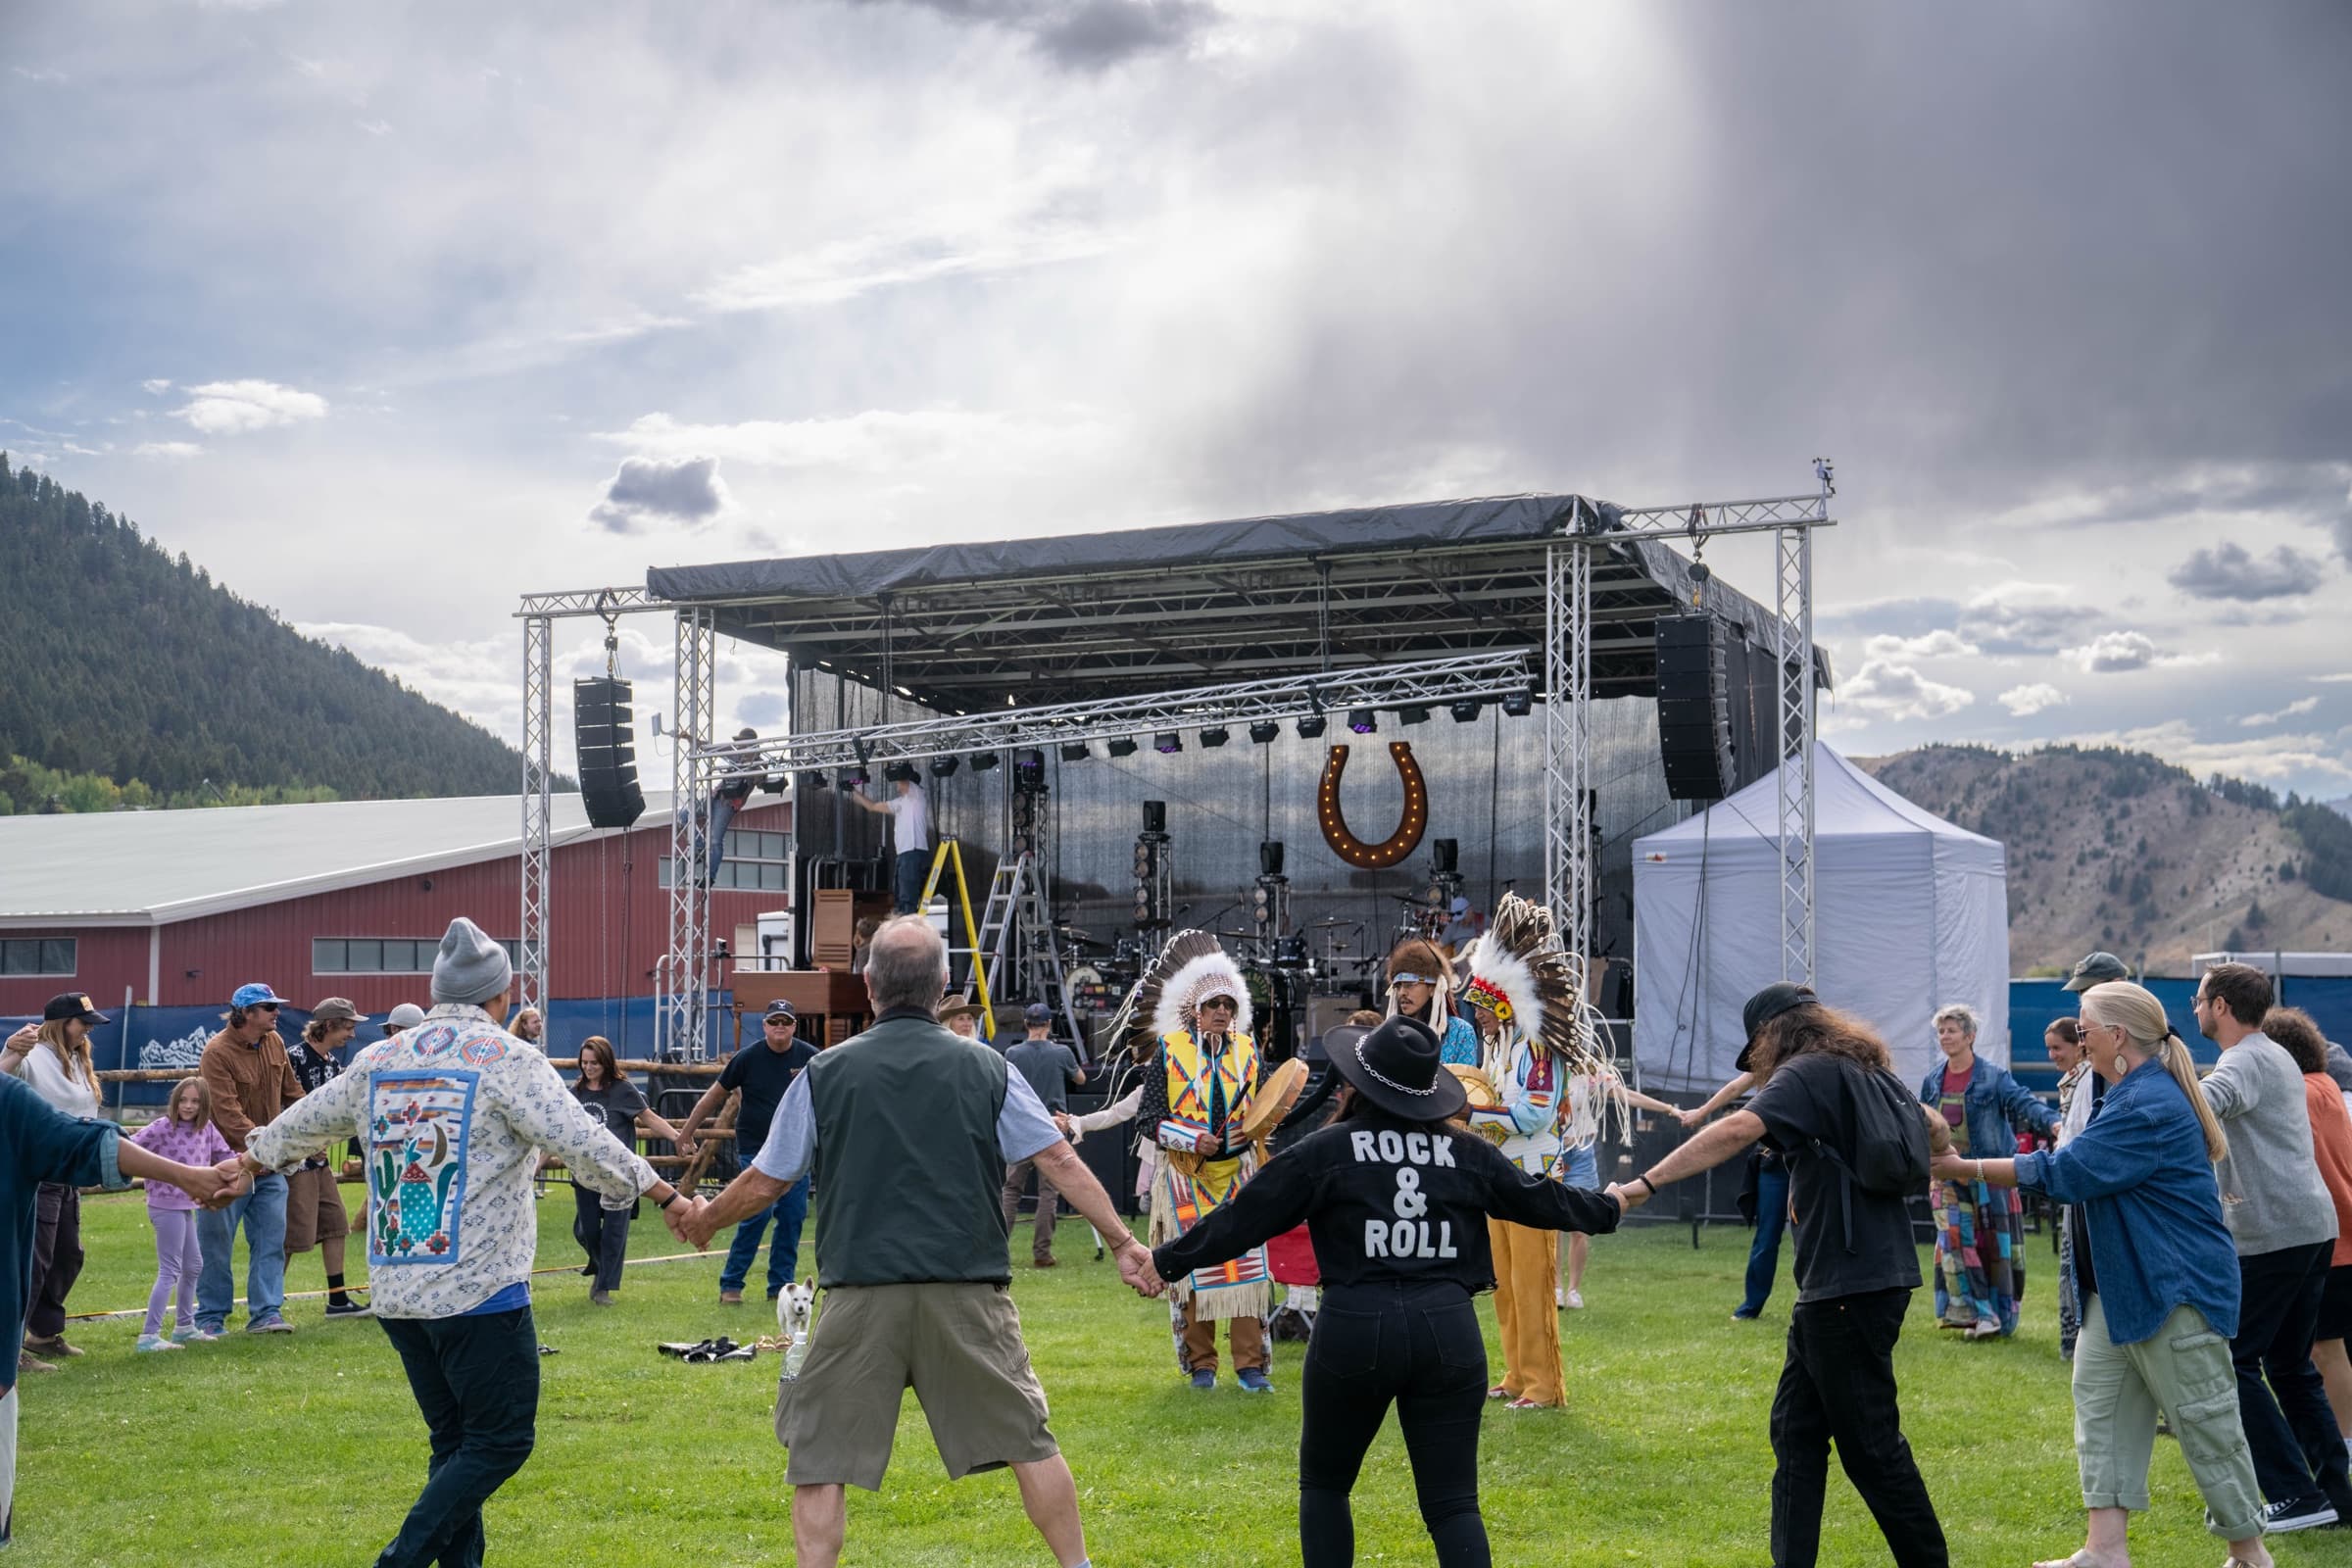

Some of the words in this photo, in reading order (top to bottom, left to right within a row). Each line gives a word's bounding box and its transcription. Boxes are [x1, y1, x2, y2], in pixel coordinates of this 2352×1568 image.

[1350, 1130, 1456, 1168] ROCK
[1394, 1166, 1428, 1219] &
[1364, 1219, 1457, 1258] ROLL
